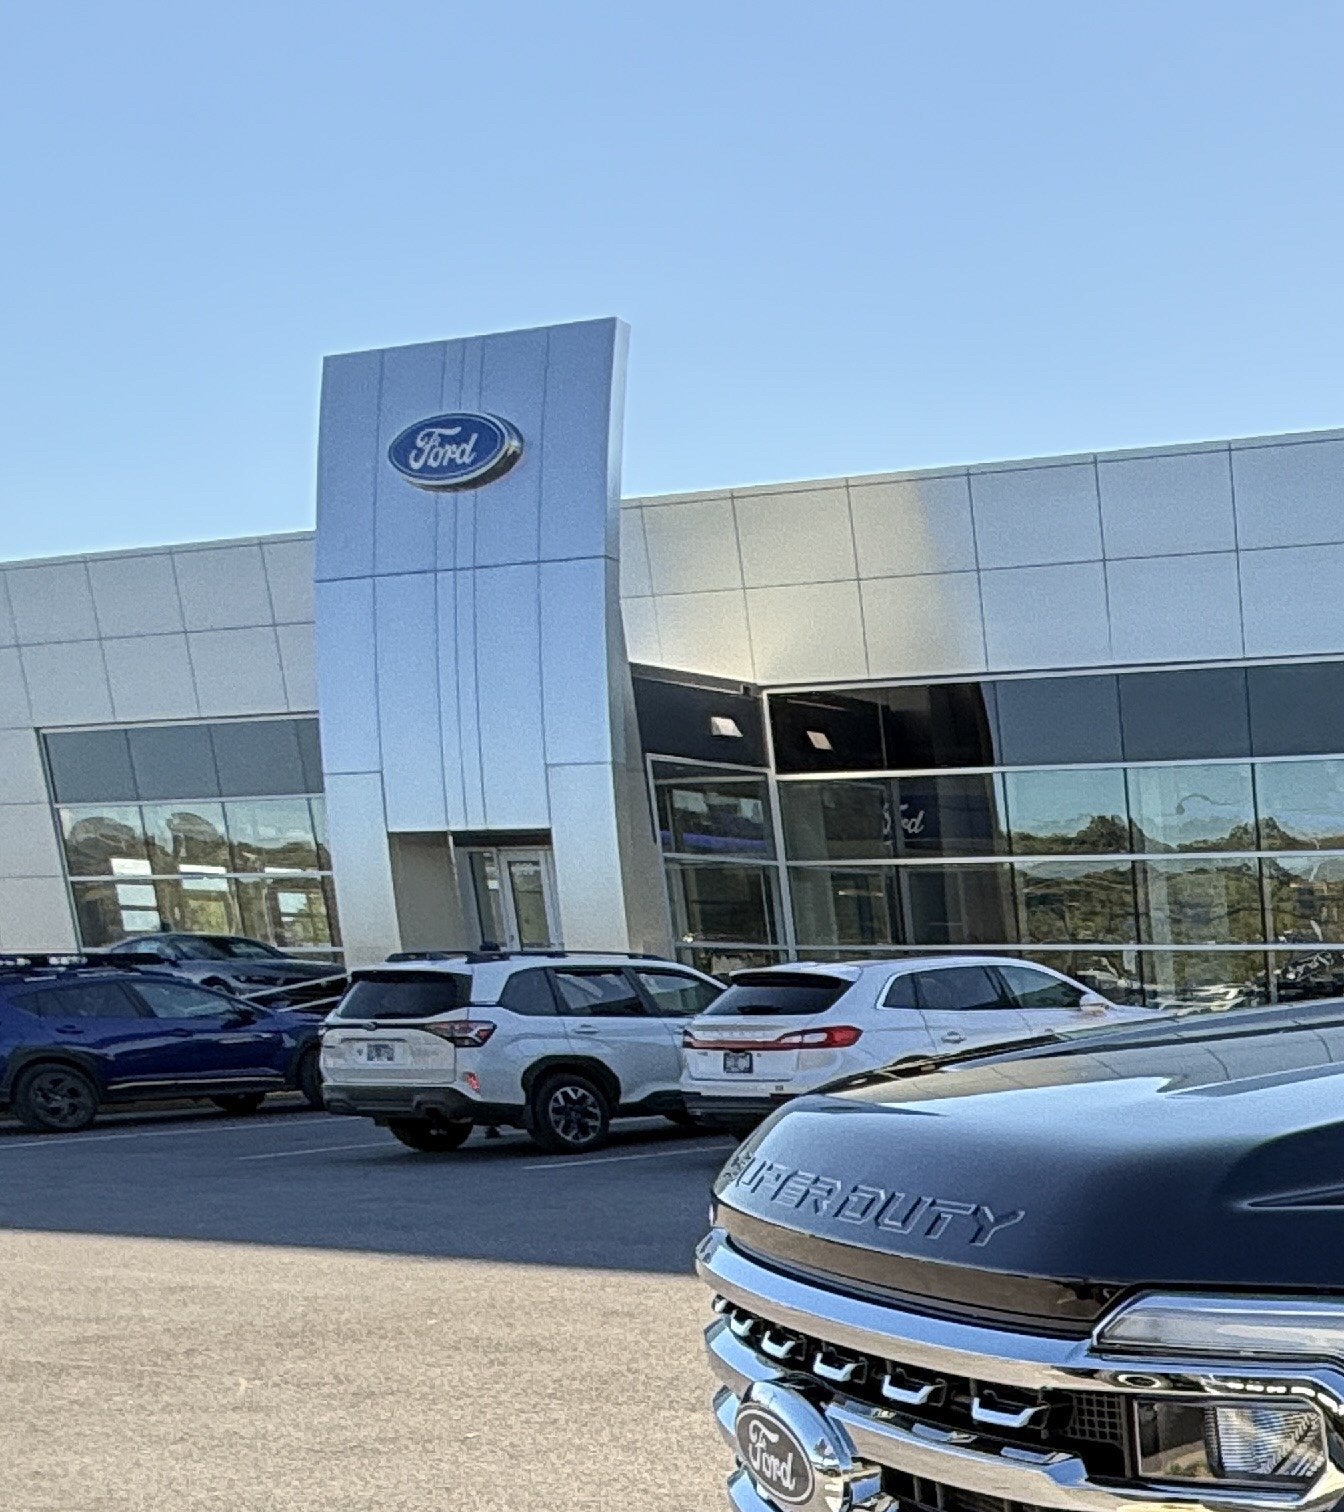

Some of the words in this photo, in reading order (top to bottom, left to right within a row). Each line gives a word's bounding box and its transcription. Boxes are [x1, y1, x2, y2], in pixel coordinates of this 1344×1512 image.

[408, 426, 479, 470] Ford
[831, 1183, 1026, 1248] DUTY
[748, 1419, 797, 1492] Ford
